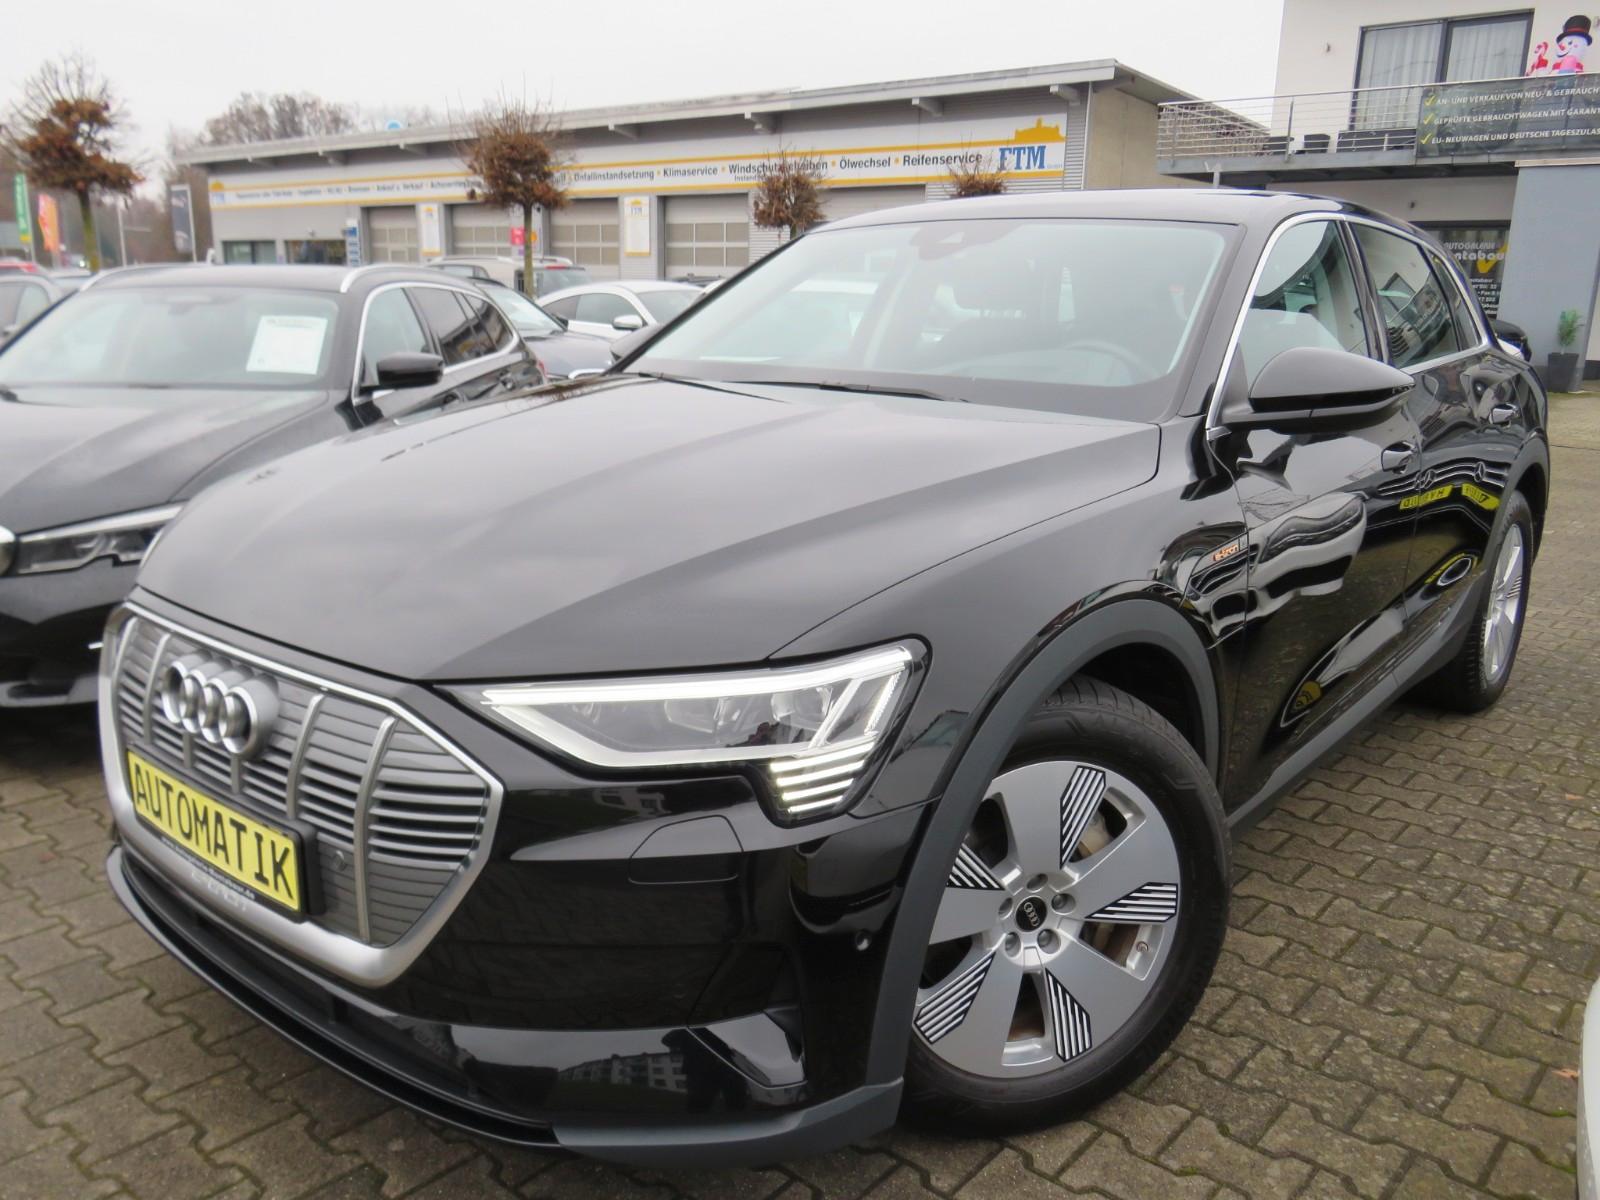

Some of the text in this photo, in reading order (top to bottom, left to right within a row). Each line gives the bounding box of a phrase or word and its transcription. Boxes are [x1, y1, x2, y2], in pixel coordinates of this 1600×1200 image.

[1469, 92, 1506, 103] VERKAUF
[1506, 92, 1523, 100] VON
[1524, 90, 1545, 99] NEU-
[1546, 89, 1552, 97] &
[1472, 110, 1549, 122] GEBRAUCHTWAGEN
[1550, 109, 1566, 117] MIT
[1490, 133, 1508, 141] UND
[1509, 130, 1550, 140] DEUTSCHE
[574, 169, 655, 183] Unfallinstandsetzung
[663, 165, 718, 178] Klimaservice
[839, 155, 892, 170] Ölwechsel
[902, 151, 983, 167] Reifenservice
[999, 145, 1047, 171] FTM
[134, 762, 294, 900] AUTOMATIK
